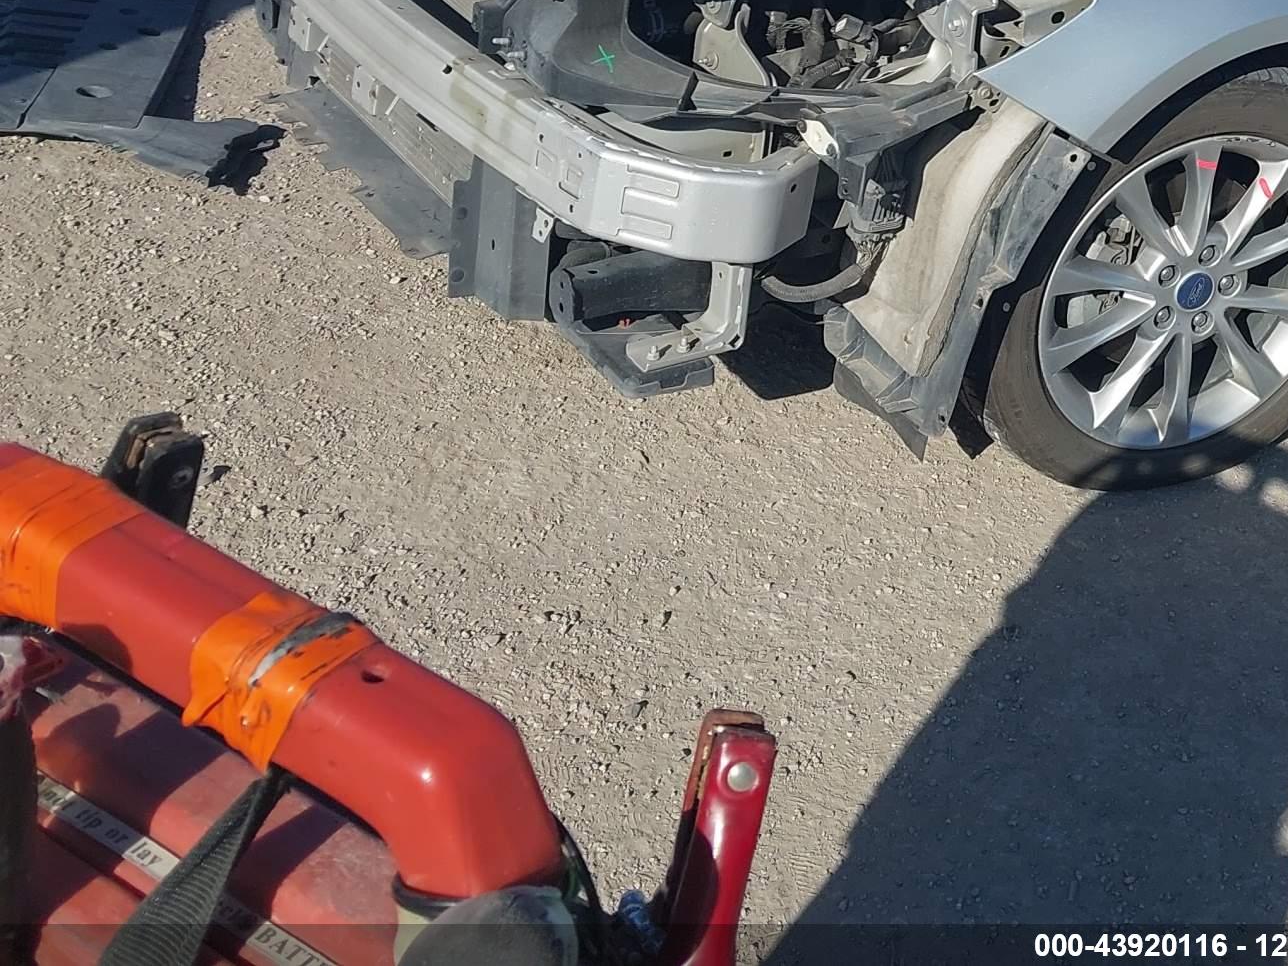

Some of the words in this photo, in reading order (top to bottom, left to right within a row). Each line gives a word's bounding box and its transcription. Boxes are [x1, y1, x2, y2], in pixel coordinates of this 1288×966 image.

[75, 809, 103, 829] tip
[105, 828, 129, 844] or
[131, 841, 163, 867] lay
[254, 926, 335, 966] BATT
